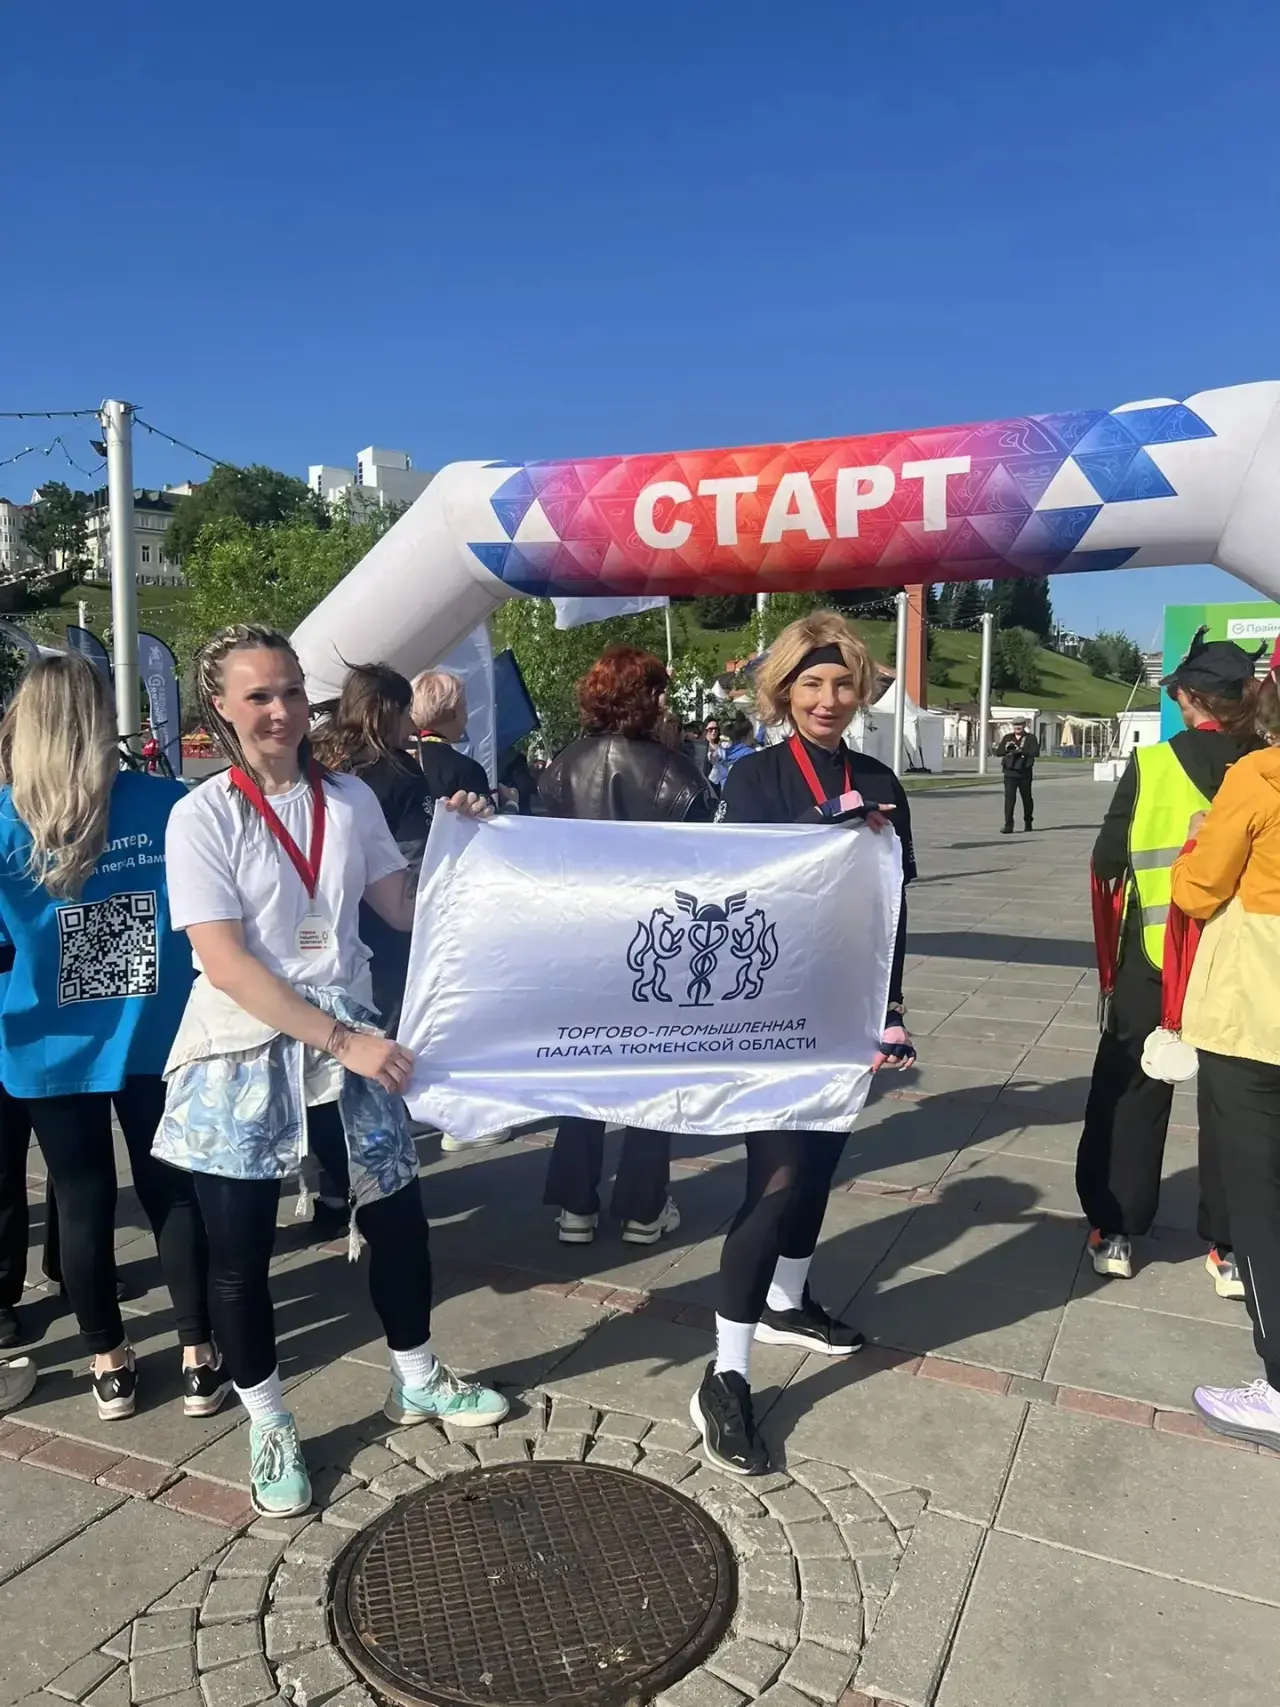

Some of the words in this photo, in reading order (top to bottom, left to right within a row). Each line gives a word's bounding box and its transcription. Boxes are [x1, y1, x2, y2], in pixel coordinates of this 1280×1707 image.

[633, 455, 971, 550] СТАРТ
[103, 833, 153, 853] алтер,
[557, 1018, 806, 1040] ТОРГОВО-ПРОМЫШЛЕННАЯ
[536, 1044, 613, 1058] ПАЛАТА
[619, 1037, 734, 1054] ТЮМЕНСКОЙ
[739, 1037, 817, 1050] ОБЛАСТИ
